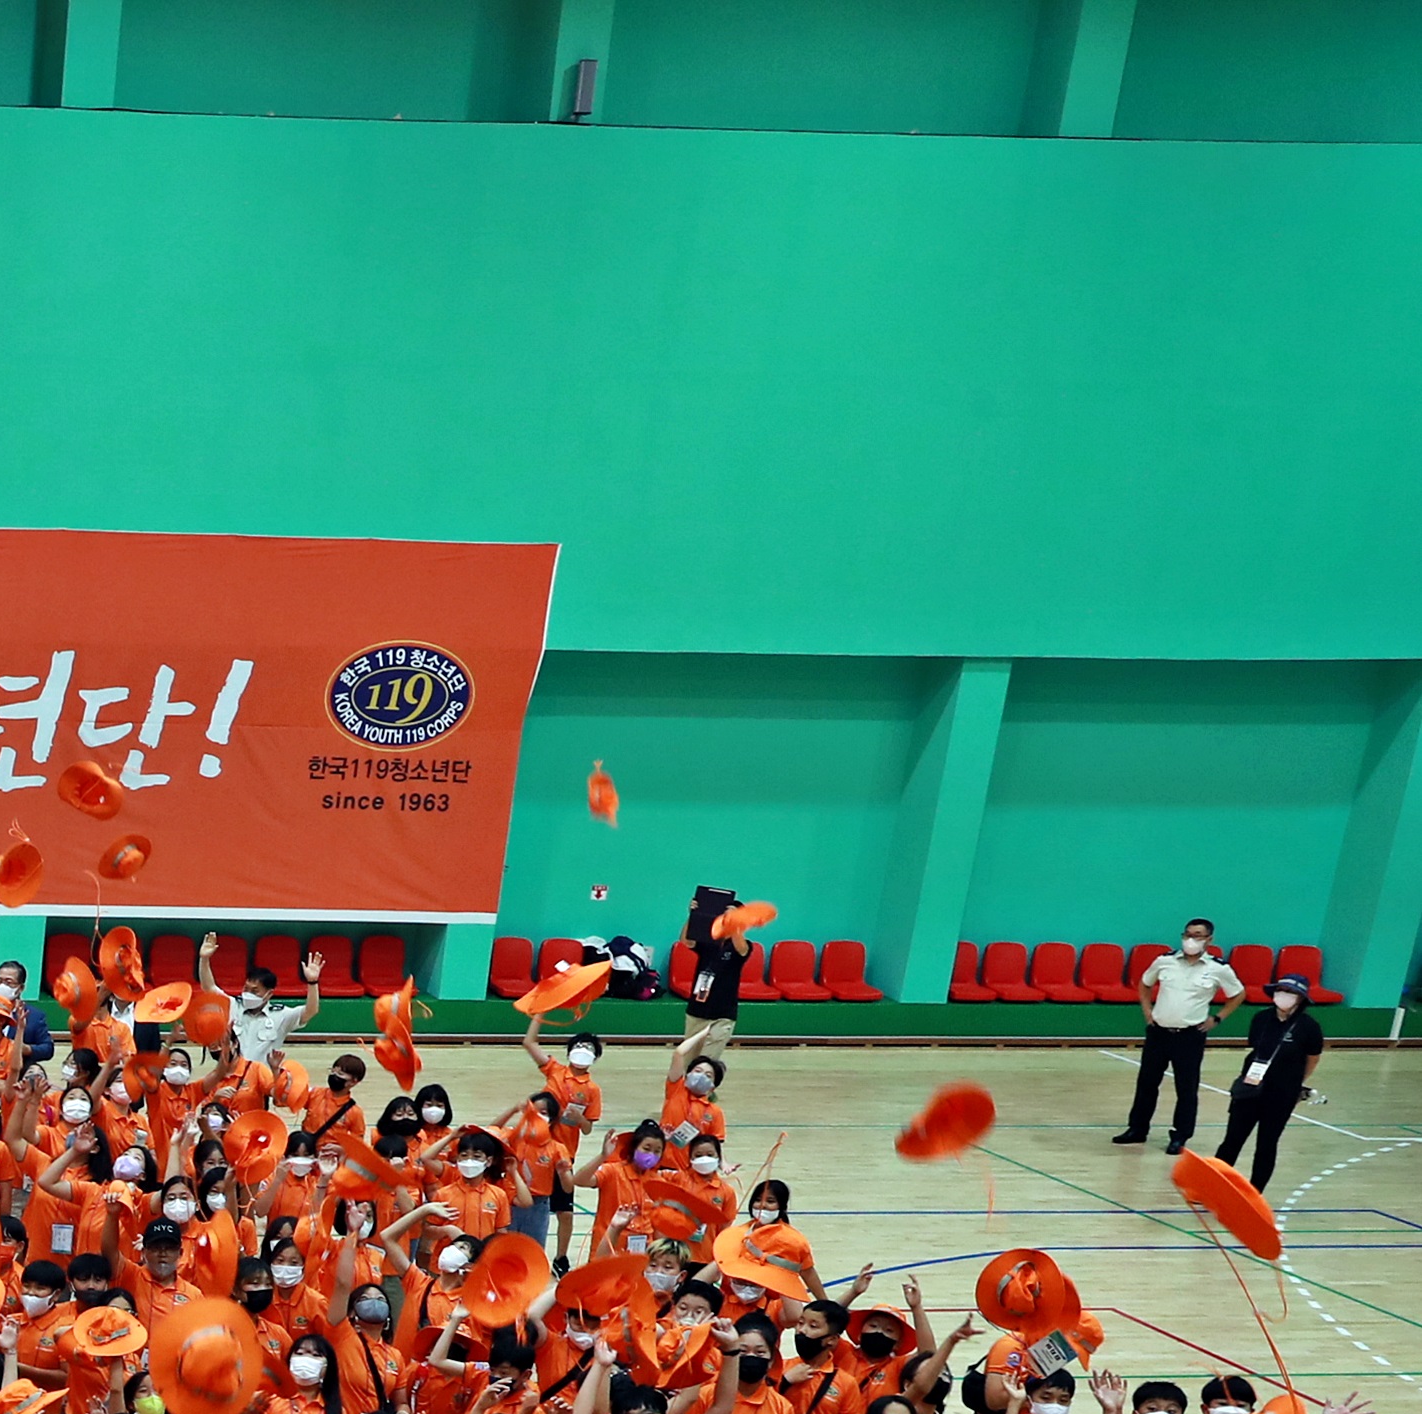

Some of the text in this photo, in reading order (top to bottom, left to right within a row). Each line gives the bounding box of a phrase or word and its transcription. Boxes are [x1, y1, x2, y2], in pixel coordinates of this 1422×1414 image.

[339, 648, 467, 694] 한국 119 청소년단
[334, 691, 464, 744] KOREA YOUTH 119 CORPS
[364, 672, 434, 725] 119
[307, 754, 473, 785] 한국119청소년단
[321, 791, 450, 812] since 1963
[153, 1224, 174, 1233] NYC
